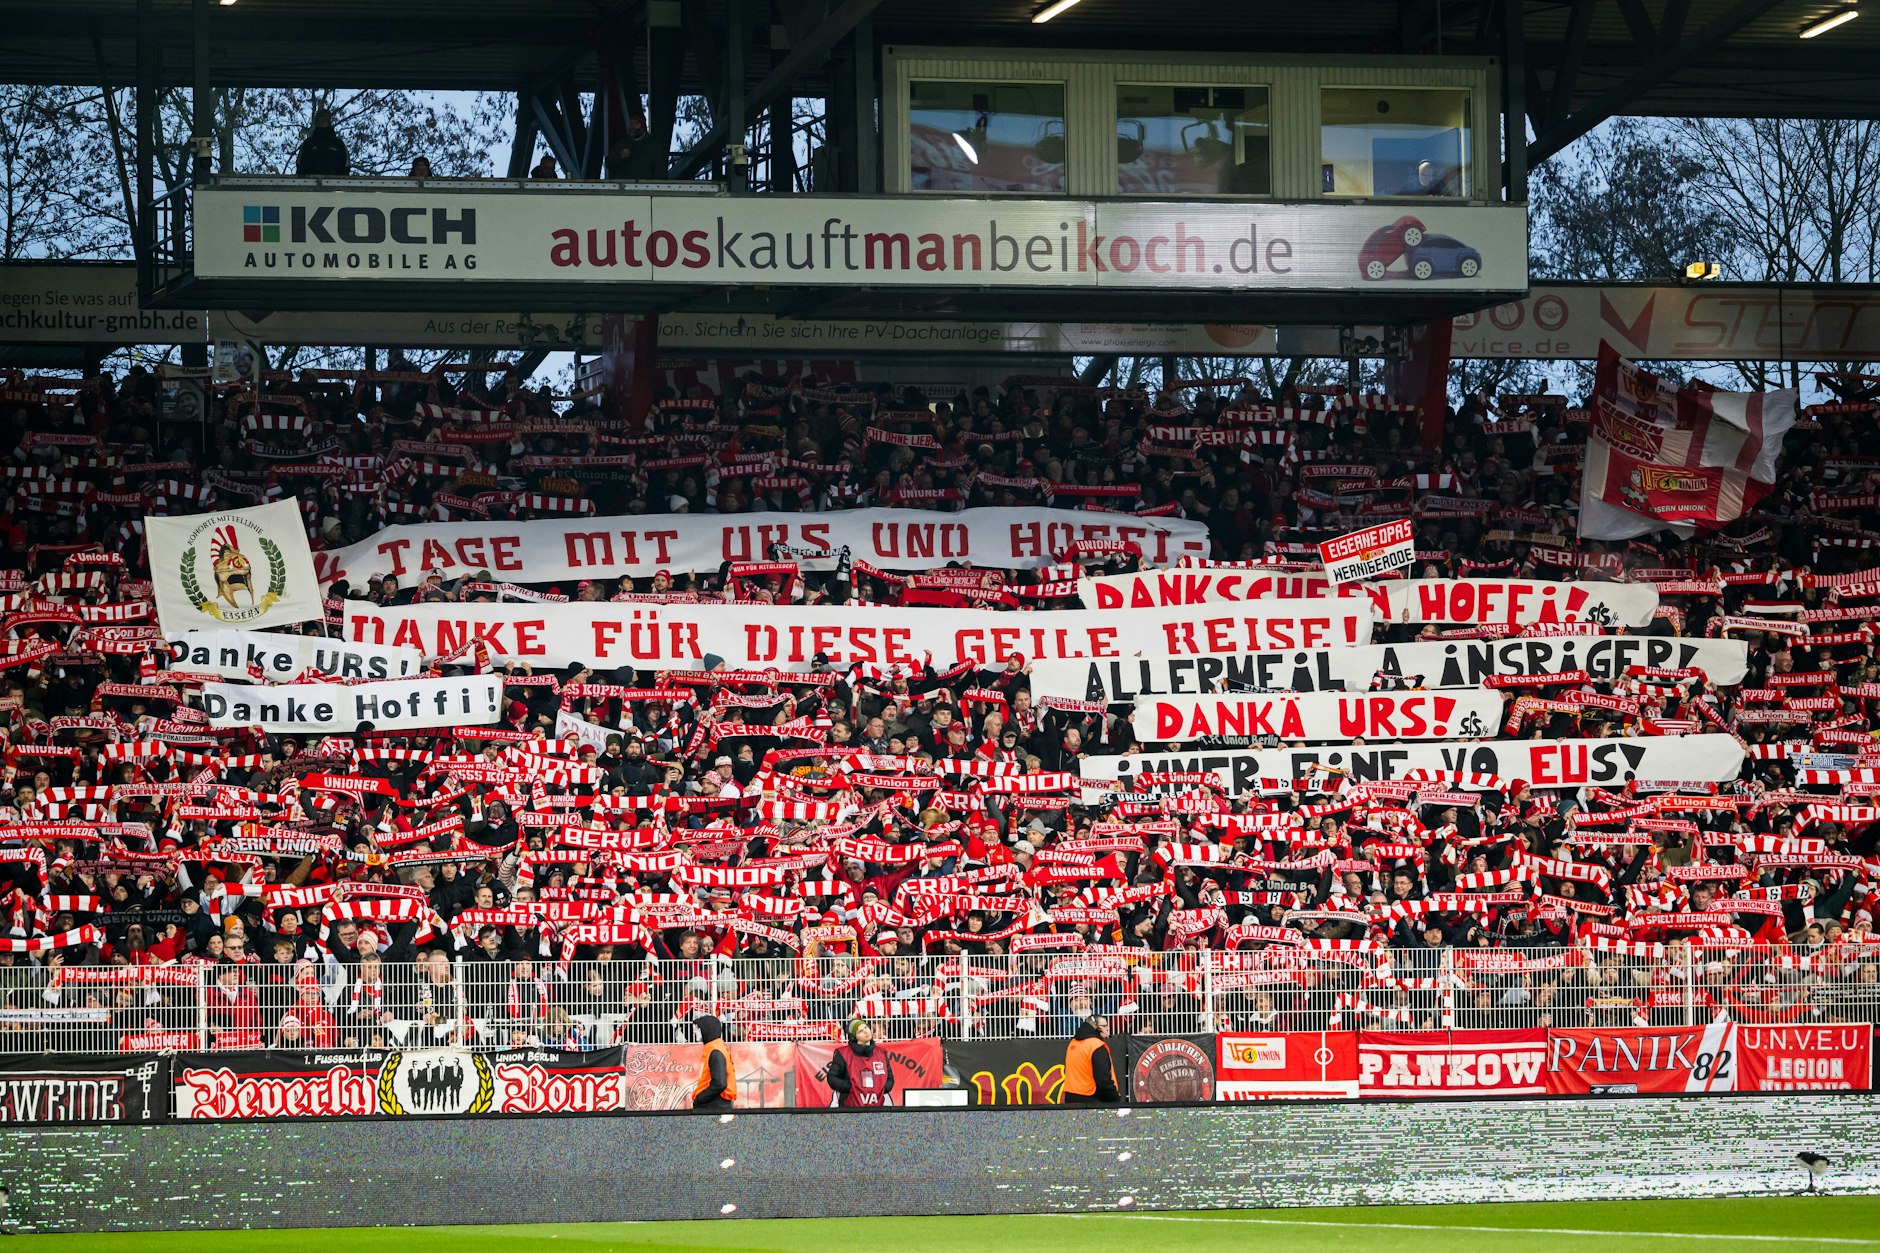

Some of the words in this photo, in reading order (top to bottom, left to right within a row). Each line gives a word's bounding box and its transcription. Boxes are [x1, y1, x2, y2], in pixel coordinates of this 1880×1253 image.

[291, 206, 477, 245] KOCH
[550, 216, 1294, 275] autoskauftmanbeikoch.de
[244, 252, 429, 269] AUTOMOBILE
[444, 254, 477, 270] AG
[45, 290, 69, 305] Sie
[74, 293, 104, 306] was
[424, 319, 455, 334] Aus
[460, 319, 491, 334] der
[695, 322, 756, 337] Sichen
[763, 322, 785, 338] Sie
[791, 323, 823, 339] sich
[828, 324, 859, 339] Ihre
[864, 325, 1005, 345] PV-Dachanlage.
[1601, 401, 1665, 436] EISERN
[1596, 428, 1656, 462] UNION
[735, 451, 775, 462] UNIONER
[458, 474, 495, 487] EISERN
[543, 480, 580, 494] UNION
[1679, 478, 1708, 491] UNION
[97, 491, 141, 503] UNIONER
[440, 494, 469, 505] Union
[899, 488, 945, 499] UNIONER
[1820, 496, 1874, 507] UNIONER
[1652, 504, 1676, 513] ISERN
[187, 519, 217, 547] KOHORTE
[216, 515, 265, 536] MITTELLINIE
[1076, 539, 1126, 551] UNIONER
[1328, 531, 1378, 559] EISERNE
[1379, 521, 1412, 545] OPAS
[377, 536, 523, 577] TAGE
[564, 530, 678, 567] MIT
[722, 523, 831, 562] URS
[872, 522, 969, 558] UND
[78, 553, 108, 562] Union
[759, 563, 796, 571] MITGLIEDER!
[1333, 548, 1414, 582] WERNIGERODE
[933, 577, 953, 585] UNION
[629, 593, 660, 601] Union
[351, 614, 546, 658] DANKE
[591, 609, 703, 660] FÜR
[744, 624, 912, 663] DIESE
[954, 627, 1121, 665] GEILE
[1162, 616, 1358, 655] REISE!
[1796, 632, 1862, 644] UNIONER
[171, 641, 294, 673] Danke
[315, 650, 409, 680] URS!
[1381, 647, 1403, 690] A
[1644, 666, 1692, 677] UNIONER
[1503, 672, 1580, 683] GEGENGERADE
[676, 690, 690, 698] NUR
[205, 693, 334, 724] Danke
[355, 685, 497, 721] Hoffi!
[1580, 693, 1617, 708] Union
[1789, 698, 1835, 709] UNIONER
[1157, 697, 1306, 739] DANKÄ
[1339, 697, 1456, 739] URS!
[1758, 712, 1784, 720] Union
[458, 727, 476, 737] FÜR
[479, 730, 538, 741] MITGLIEDER!
[1823, 731, 1872, 743] UNIONER
[17, 745, 72, 755] UNIONER
[1530, 743, 1646, 785] EUS!
[323, 777, 379, 791] UNIONER
[857, 775, 872, 785] FC
[874, 777, 911, 788] Union
[1153, 774, 1166, 784] FC
[1168, 772, 1201, 783] Union
[1654, 780, 1678, 788] UNION
[1080, 782, 1110, 790] UNION
[1019, 797, 1047, 806] Union
[1420, 792, 1443, 800] SUPER
[1458, 794, 1481, 802] UNION
[1656, 797, 1671, 807] FC
[1673, 796, 1707, 807] Union
[179, 806, 231, 816] MITGLIEDER
[234, 807, 251, 817] FÜR
[1573, 812, 1592, 823] NUR
[1593, 811, 1611, 822] FÜR
[21, 827, 41, 837] FÜR
[123, 828, 148, 838] WEISS
[375, 831, 394, 844] NUR
[395, 829, 415, 841] FÜR
[682, 829, 723, 840] Eisern
[1069, 841, 1080, 850] FC
[1084, 838, 1115, 848] UNION
[1760, 854, 1808, 864] EISERN
[1812, 854, 1862, 864] UNION
[680, 866, 784, 886] UNION
[1049, 866, 1105, 877] UNIONER
[348, 884, 362, 892] FC
[365, 884, 400, 894] UNION
[1154, 883, 1165, 894] FC
[1266, 880, 1297, 891] Union
[1124, 884, 1152, 900] Union
[1456, 893, 1489, 901] UNION
[1720, 901, 1735, 910] WIR
[1737, 901, 1768, 910] UNIONER
[463, 911, 537, 924] UNIONER
[676, 914, 701, 923] UNION
[1646, 913, 1675, 924] SPIELT
[1241, 925, 1288, 942] UNION
[1591, 923, 1625, 935] UNION
[1019, 936, 1032, 946] FC
[1034, 935, 1065, 945] UNION
[1744, 1028, 1865, 1050] U.N.V.E.U.
[314, 1053, 383, 1064] FUSSBALLCLUB
[496, 1054, 525, 1062] UNION
[528, 1052, 560, 1062] BERLIN
[1141, 1052, 1157, 1069] DIE
[1157, 1040, 1206, 1065] ÜBLICHEN
[1258, 1049, 1281, 1062] UNION
[1549, 1033, 1698, 1073] PANIK
[1693, 1050, 1732, 1081] 82
[626, 1051, 694, 1074] Sektion
[1159, 1059, 1189, 1073] EISERN
[1360, 1051, 1546, 1086] PANKOW
[1766, 1055, 1844, 1080] LEGION
[1164, 1068, 1196, 1080] UNION
[183, 1065, 376, 1118] Beverly
[498, 1064, 621, 1113] Boys
[859, 1093, 878, 1105] VA
